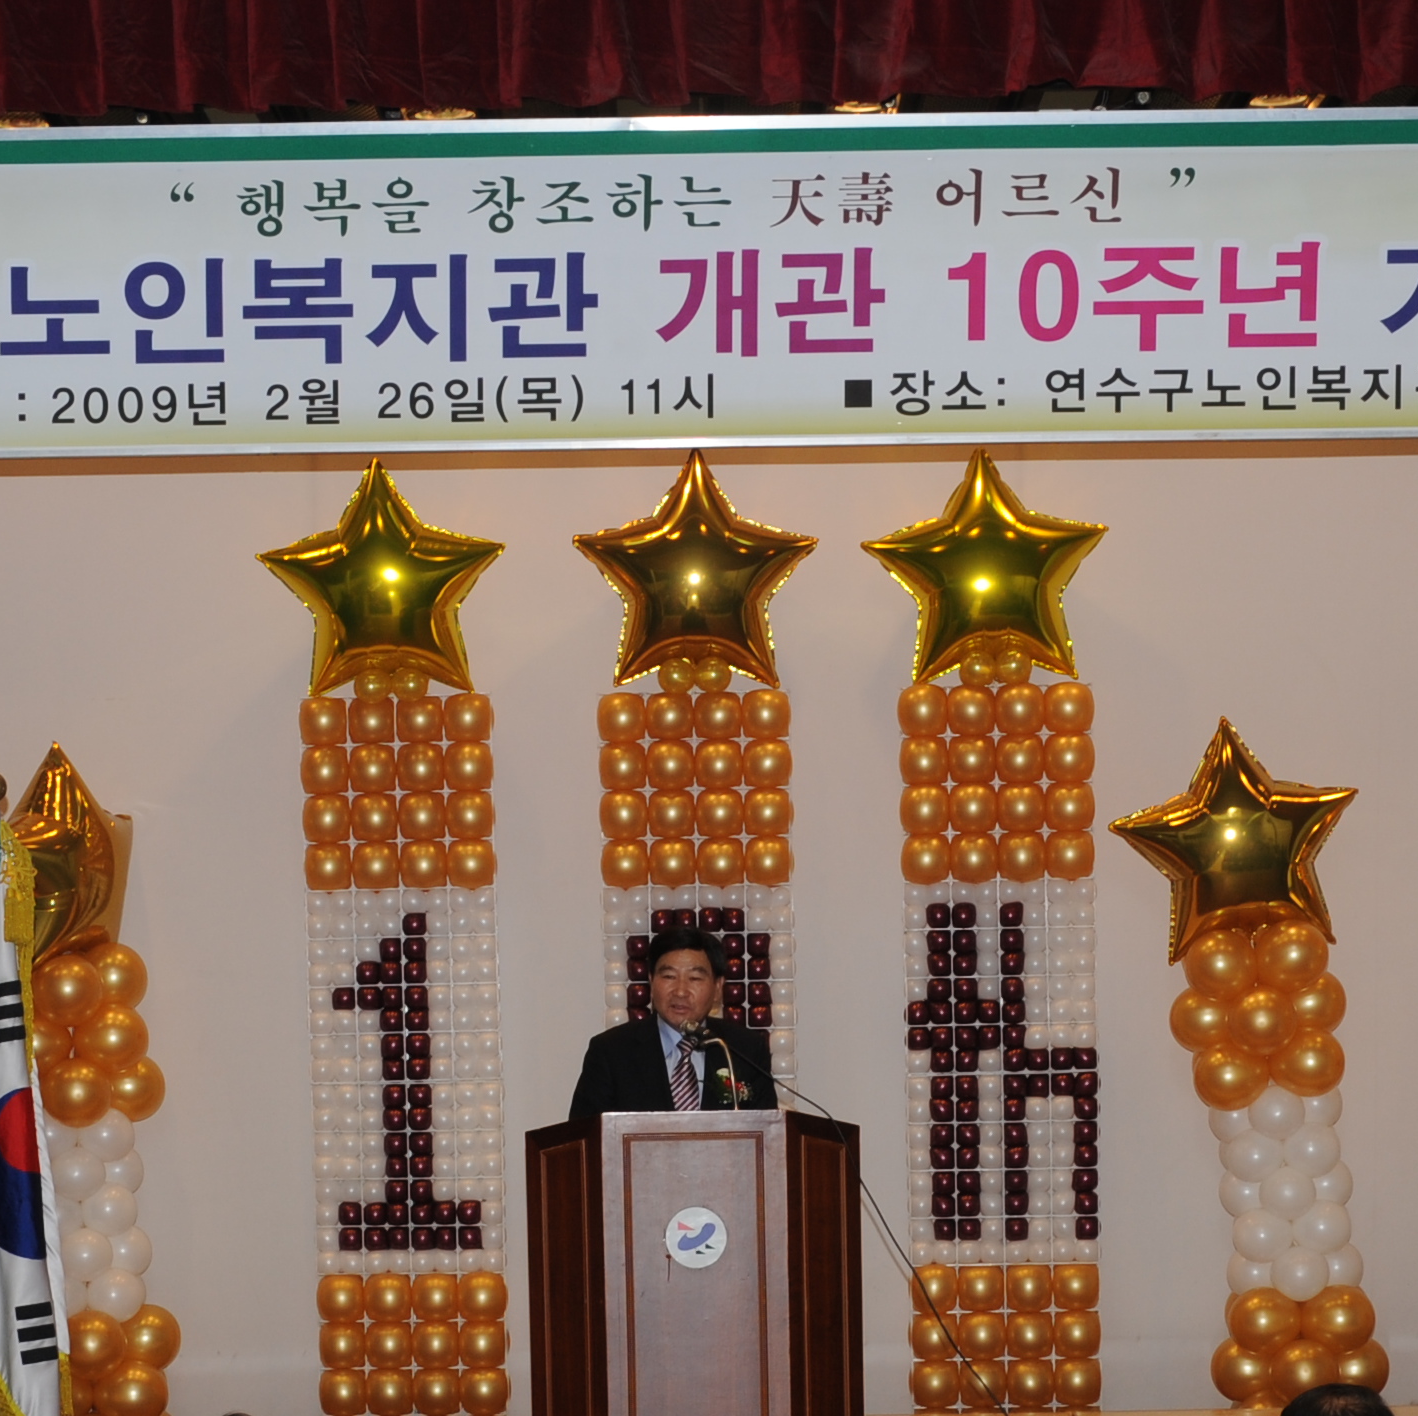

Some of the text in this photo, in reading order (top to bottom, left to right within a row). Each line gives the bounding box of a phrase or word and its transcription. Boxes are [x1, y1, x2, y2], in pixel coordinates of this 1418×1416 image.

[467, 174, 732, 235] 창조하는
[771, 171, 893, 227] 天壽
[935, 167, 1122, 226] 어르신
[656, 245, 886, 357] 개관
[947, 240, 1322, 352] 10주년
[50, 380, 229, 427] 2009년
[265, 378, 343, 426] 2월
[377, 372, 585, 424] 26일(목)
[620, 373, 718, 420] 11시
